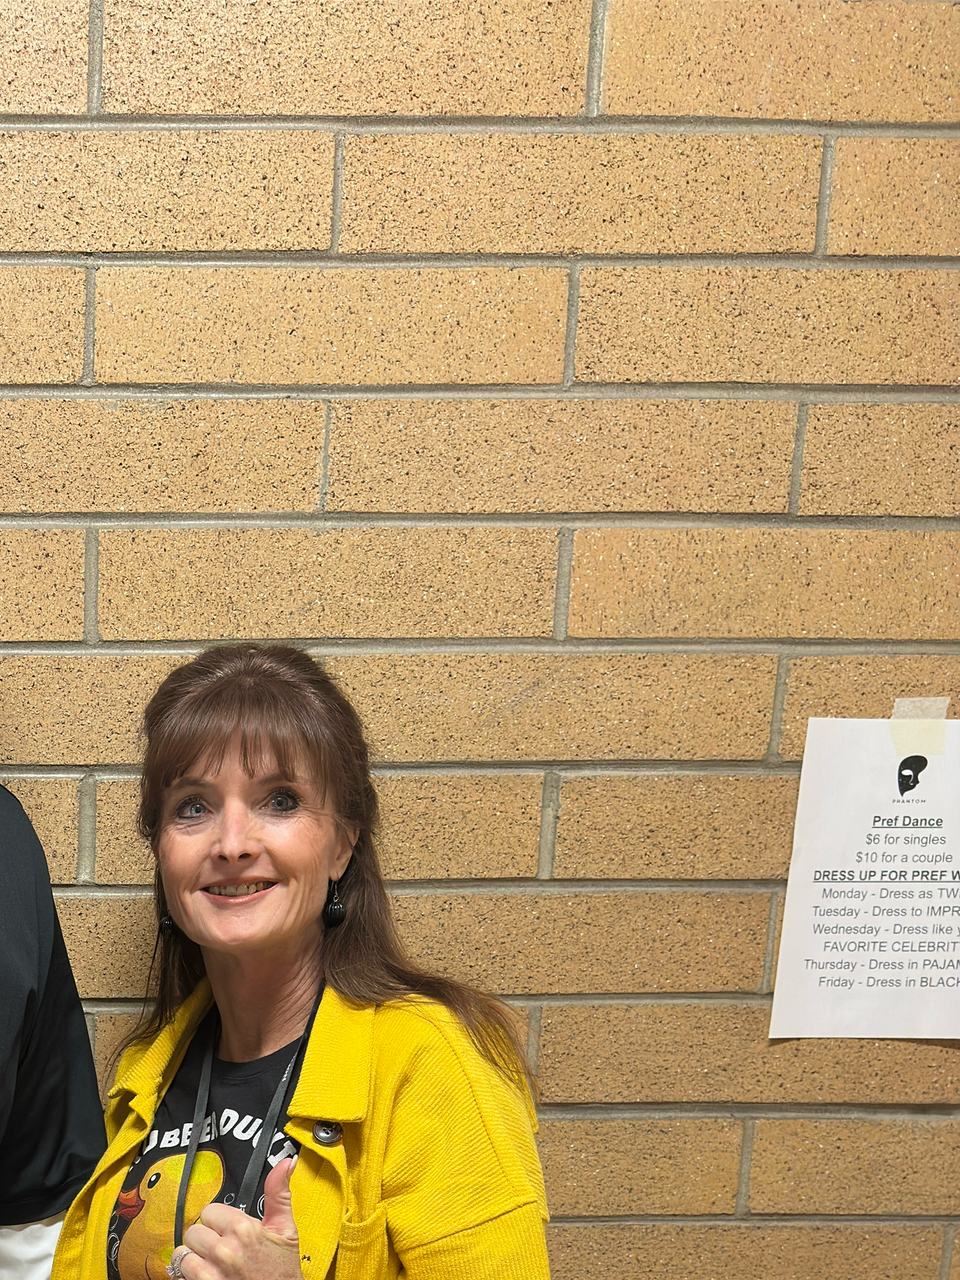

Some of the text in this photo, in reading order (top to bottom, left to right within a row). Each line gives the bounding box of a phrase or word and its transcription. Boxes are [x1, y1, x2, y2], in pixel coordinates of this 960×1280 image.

[872, 815, 943, 827] Pref Dance
[866, 833, 946, 847] $6 for singles
[855, 851, 953, 865] $10 for a couple
[813, 870, 855, 881] DRESS
[859, 870, 876, 881] UP
[880, 870, 907, 881] FOR
[911, 870, 947, 881] PREF
[822, 888, 868, 901] Monday
[879, 887, 914, 899] Dress
[918, 890, 933, 899] as
[812, 905, 860, 919] Tuesday
[872, 905, 907, 917] Dress
[911, 907, 922, 917] to
[813, 923, 881, 937] Wednesday
[893, 923, 928, 935] Dress
[932, 924, 953, 935] like
[823, 941, 887, 952] FAVORITE
[804, 959, 857, 972] Thursday
[869, 959, 904, 970] Dress
[908, 959, 918, 970] in
[818, 977, 855, 989] Friday
[866, 976, 901, 988] Dress
[905, 977, 916, 988] in
